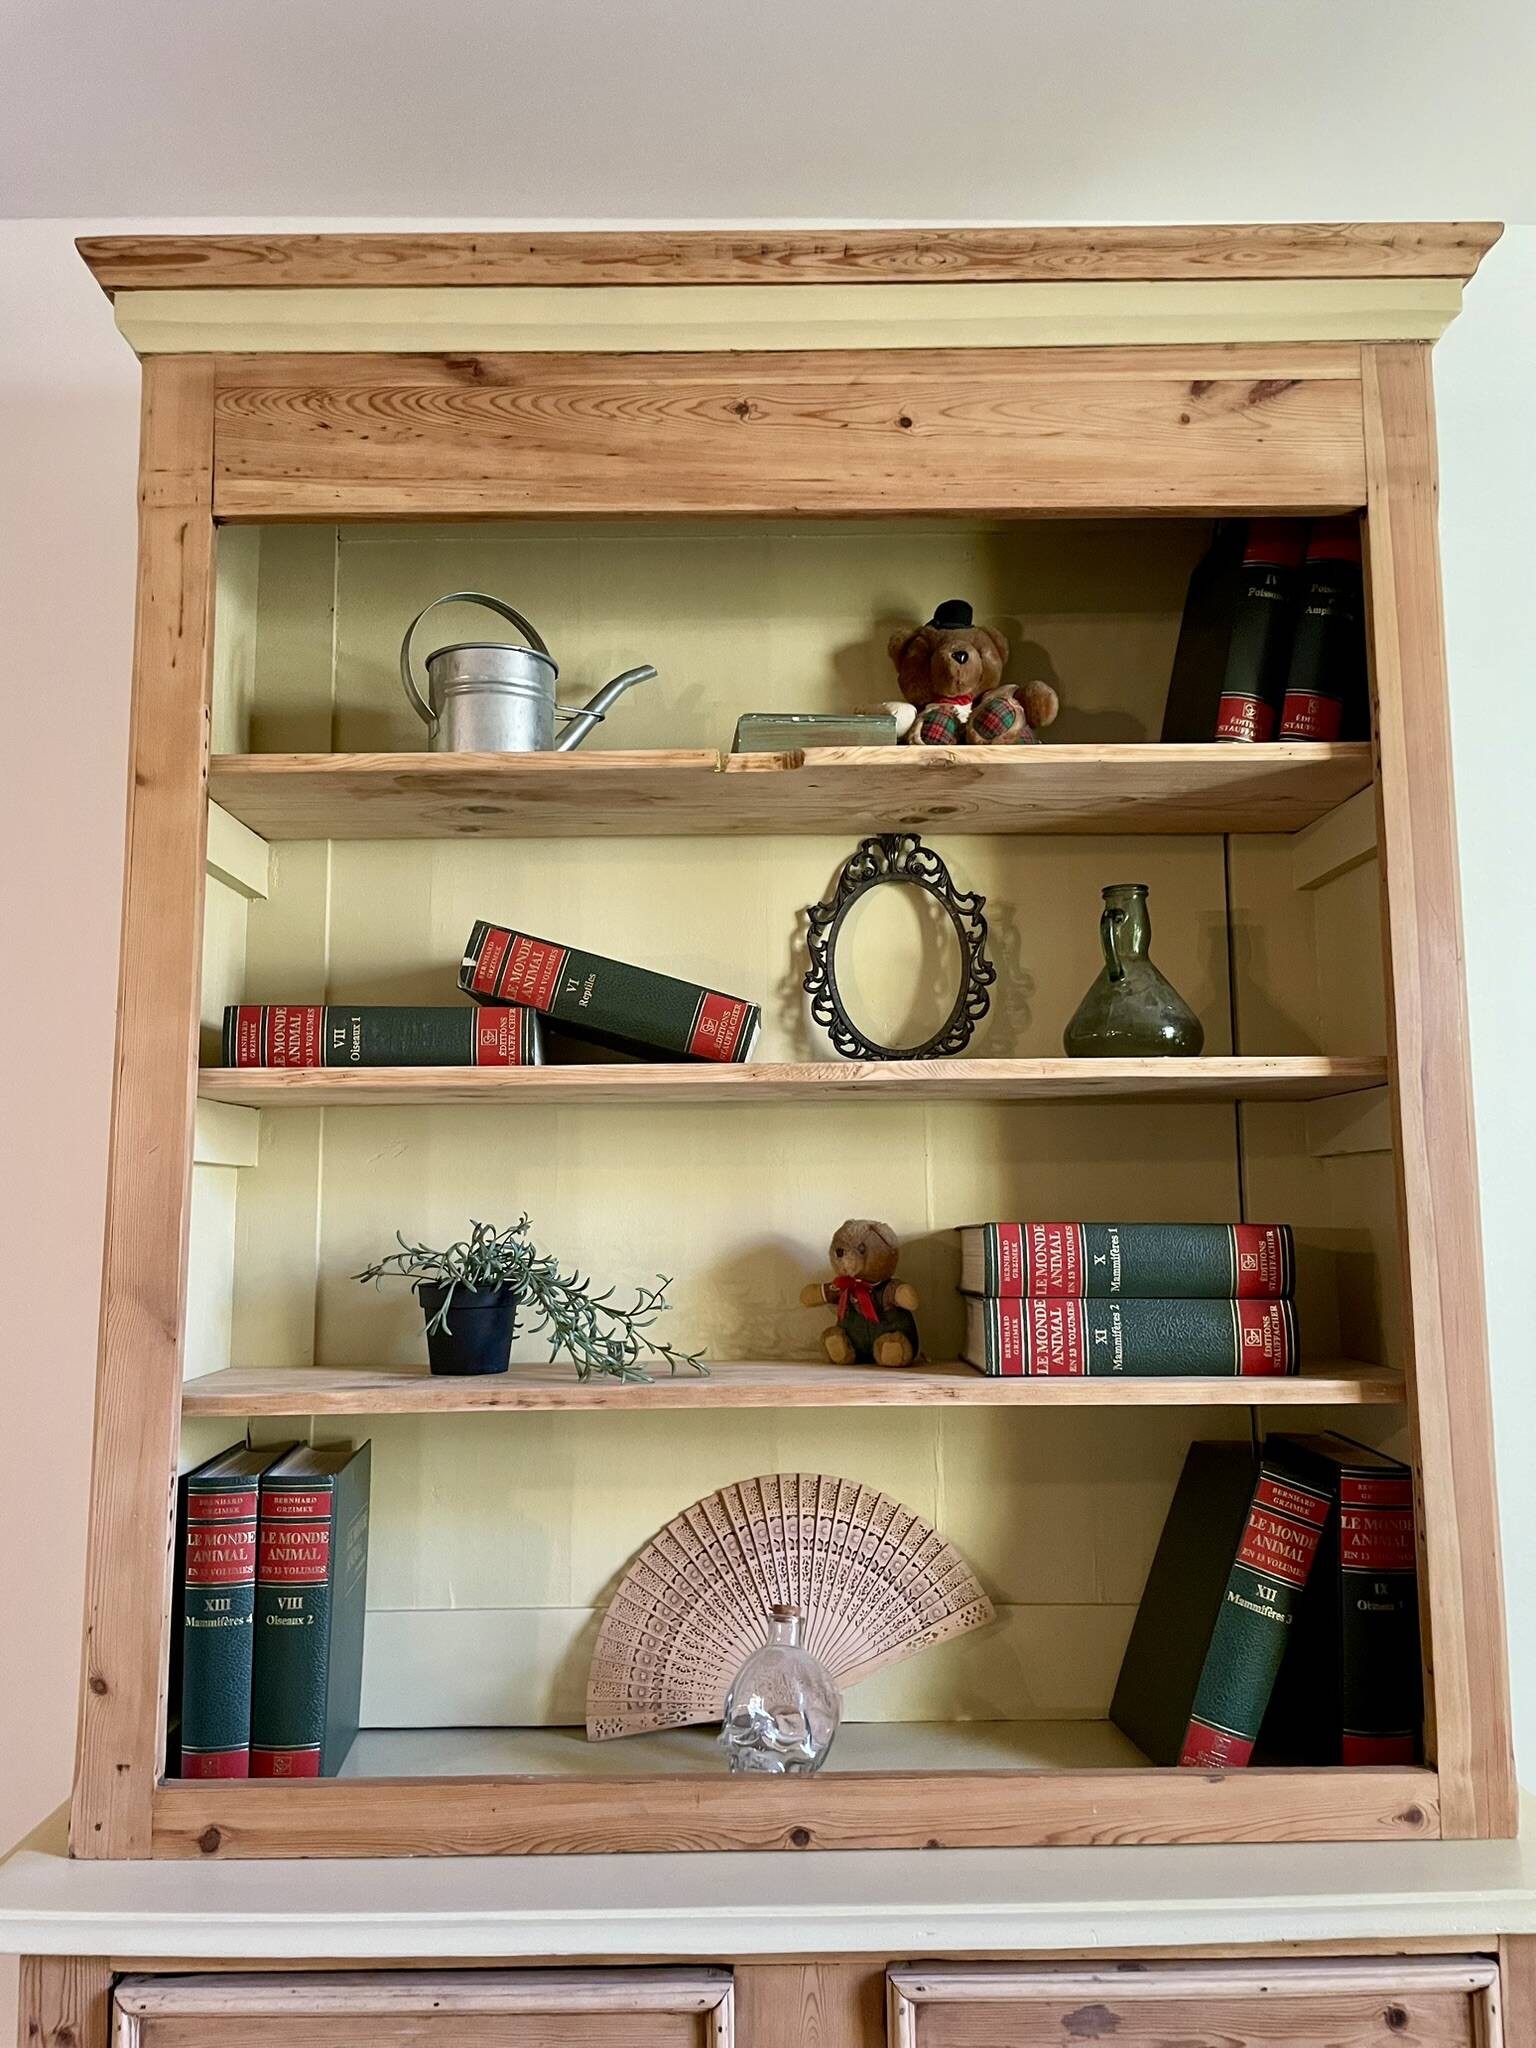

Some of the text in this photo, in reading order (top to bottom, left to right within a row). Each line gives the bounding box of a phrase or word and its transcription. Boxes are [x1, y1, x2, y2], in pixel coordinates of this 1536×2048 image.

[505, 938, 534, 1000] LE MONDE
[521, 950, 545, 998] ANIMAL
[541, 948, 559, 985] VOLUMES
[565, 978, 580, 993] VI
[578, 973, 597, 1008] Reptiles
[273, 1006, 287, 1053] MONDE
[288, 1013, 302, 1064] ANIMAL
[305, 1008, 315, 1046] VOLUMES
[333, 1028, 346, 1048] VII
[350, 1024, 360, 1061] Oiseaux
[1033, 1224, 1048, 1295] LE MONDE
[1049, 1230, 1063, 1287] ANIMAL
[1065, 1225, 1076, 1269] VOLUMES
[1094, 1254, 1106, 1265] X
[1110, 1235, 1120, 1293] Mammifères
[1067, 1281, 1076, 1293] EN
[1003, 1315, 1011, 1359] BERNHARD
[1034, 1299, 1049, 1375] LE MONDE
[1050, 1307, 1064, 1365] ANIMAL
[1066, 1301, 1077, 1346] VOLUMES
[1095, 1328, 1107, 1345] XI
[1111, 1313, 1123, 1371] Mammifères
[1069, 1360, 1077, 1372] EN
[1272, 1487, 1316, 1508] BERNHARD
[1273, 1497, 1310, 1516] GRZIMEK
[1248, 1514, 1318, 1550] LE MONDE
[1340, 1515, 1361, 1529] LE
[187, 1530, 256, 1546] LE MONDE
[262, 1531, 330, 1544] LE MONDE
[1252, 1534, 1305, 1563] ANIMAL
[193, 1548, 248, 1562] ANIMAL
[268, 1547, 321, 1560] ANIMAL
[283, 1565, 327, 1575] VOLUMES
[204, 1598, 232, 1612] XIII
[277, 1597, 304, 1610] VIII
[1227, 1591, 1285, 1622] Mammifères
[1255, 1583, 1278, 1602] XII
[185, 1613, 253, 1628] Mammifères 4
[266, 1614, 314, 1626] Oiseaux 2
